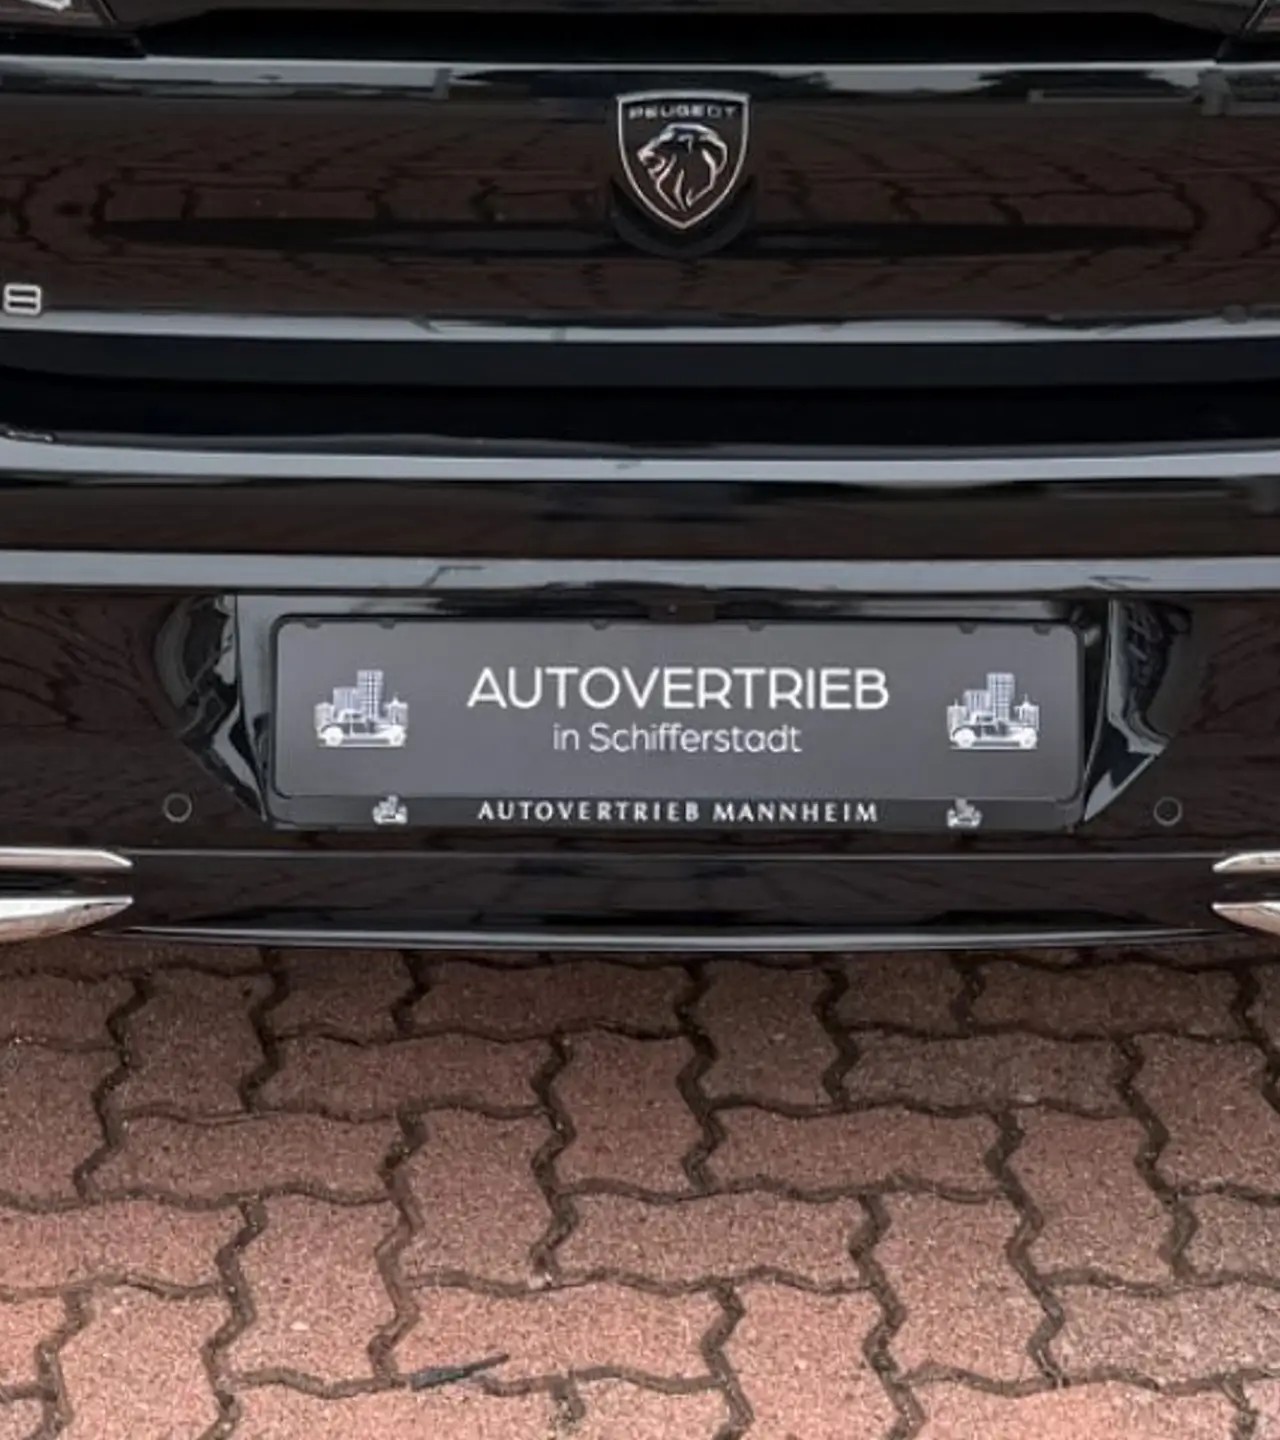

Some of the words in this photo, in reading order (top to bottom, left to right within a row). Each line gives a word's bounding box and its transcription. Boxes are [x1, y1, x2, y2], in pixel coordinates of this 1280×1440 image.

[627, 103, 737, 120] PEUGEOT
[466, 665, 890, 711] AUTOVERTRIEB
[552, 722, 581, 753] in
[587, 721, 803, 755] Schifferstadt
[477, 800, 700, 823] AUTOVERTRIEB
[712, 801, 878, 823] MANNHEIM
